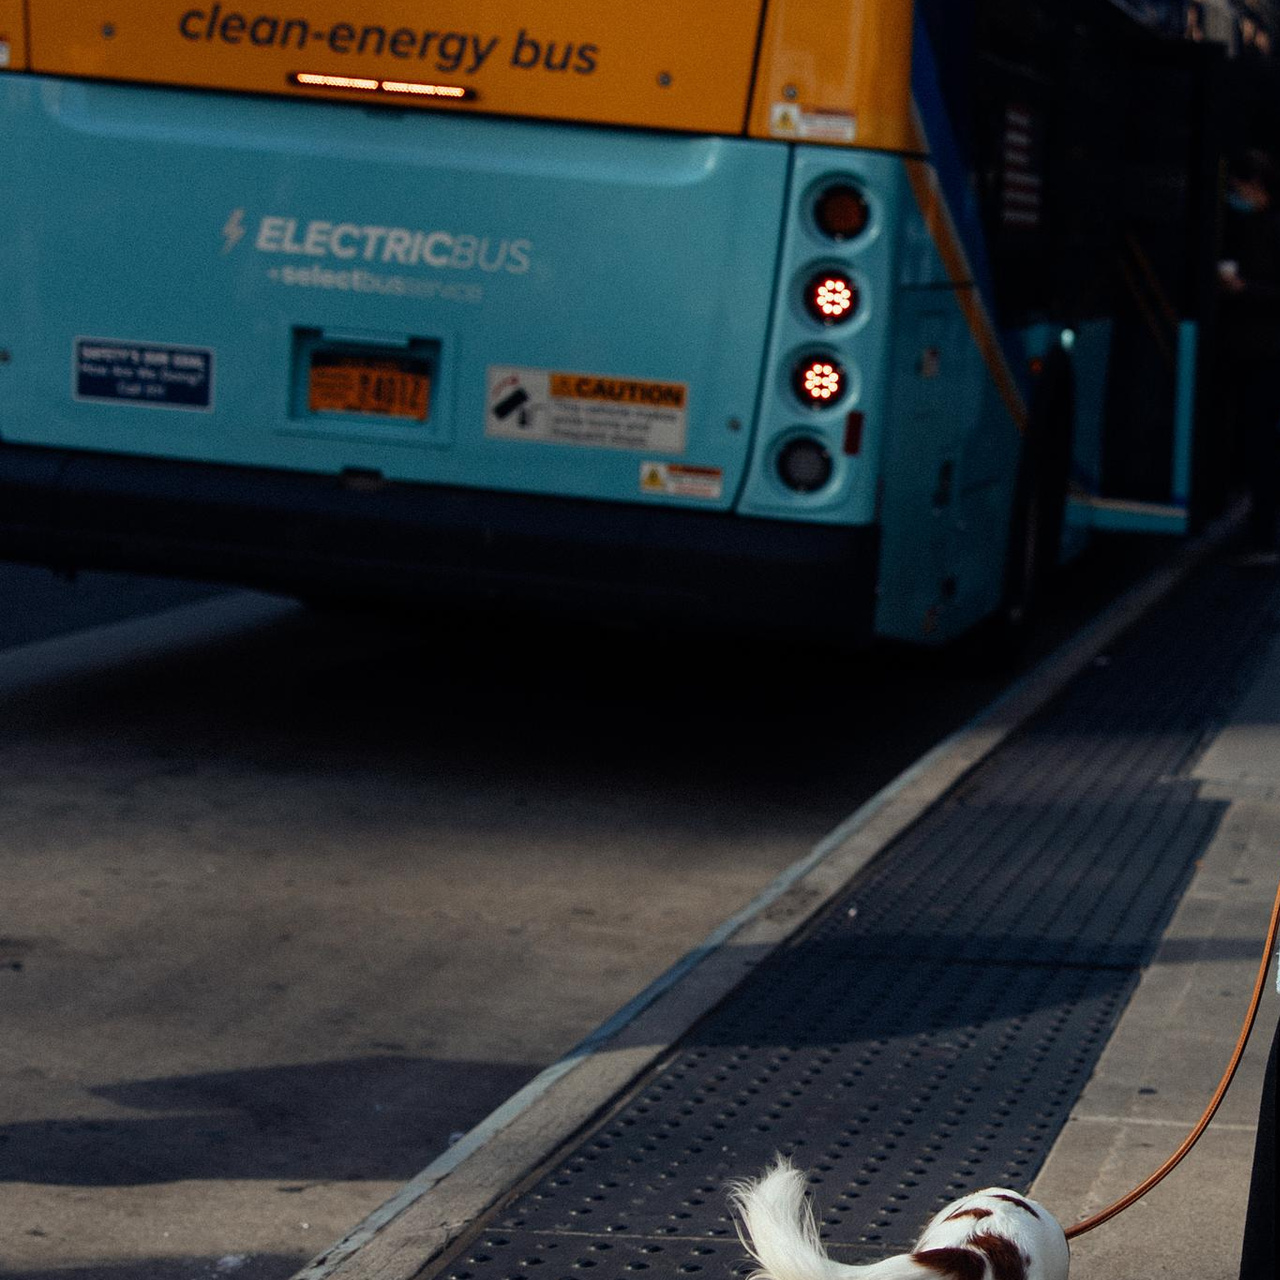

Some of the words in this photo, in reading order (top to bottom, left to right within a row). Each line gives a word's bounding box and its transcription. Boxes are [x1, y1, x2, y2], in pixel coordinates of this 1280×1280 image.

[178, 1, 498, 74] clean-energy
[510, 28, 600, 75] bus
[575, 377, 682, 406] CAUTION
